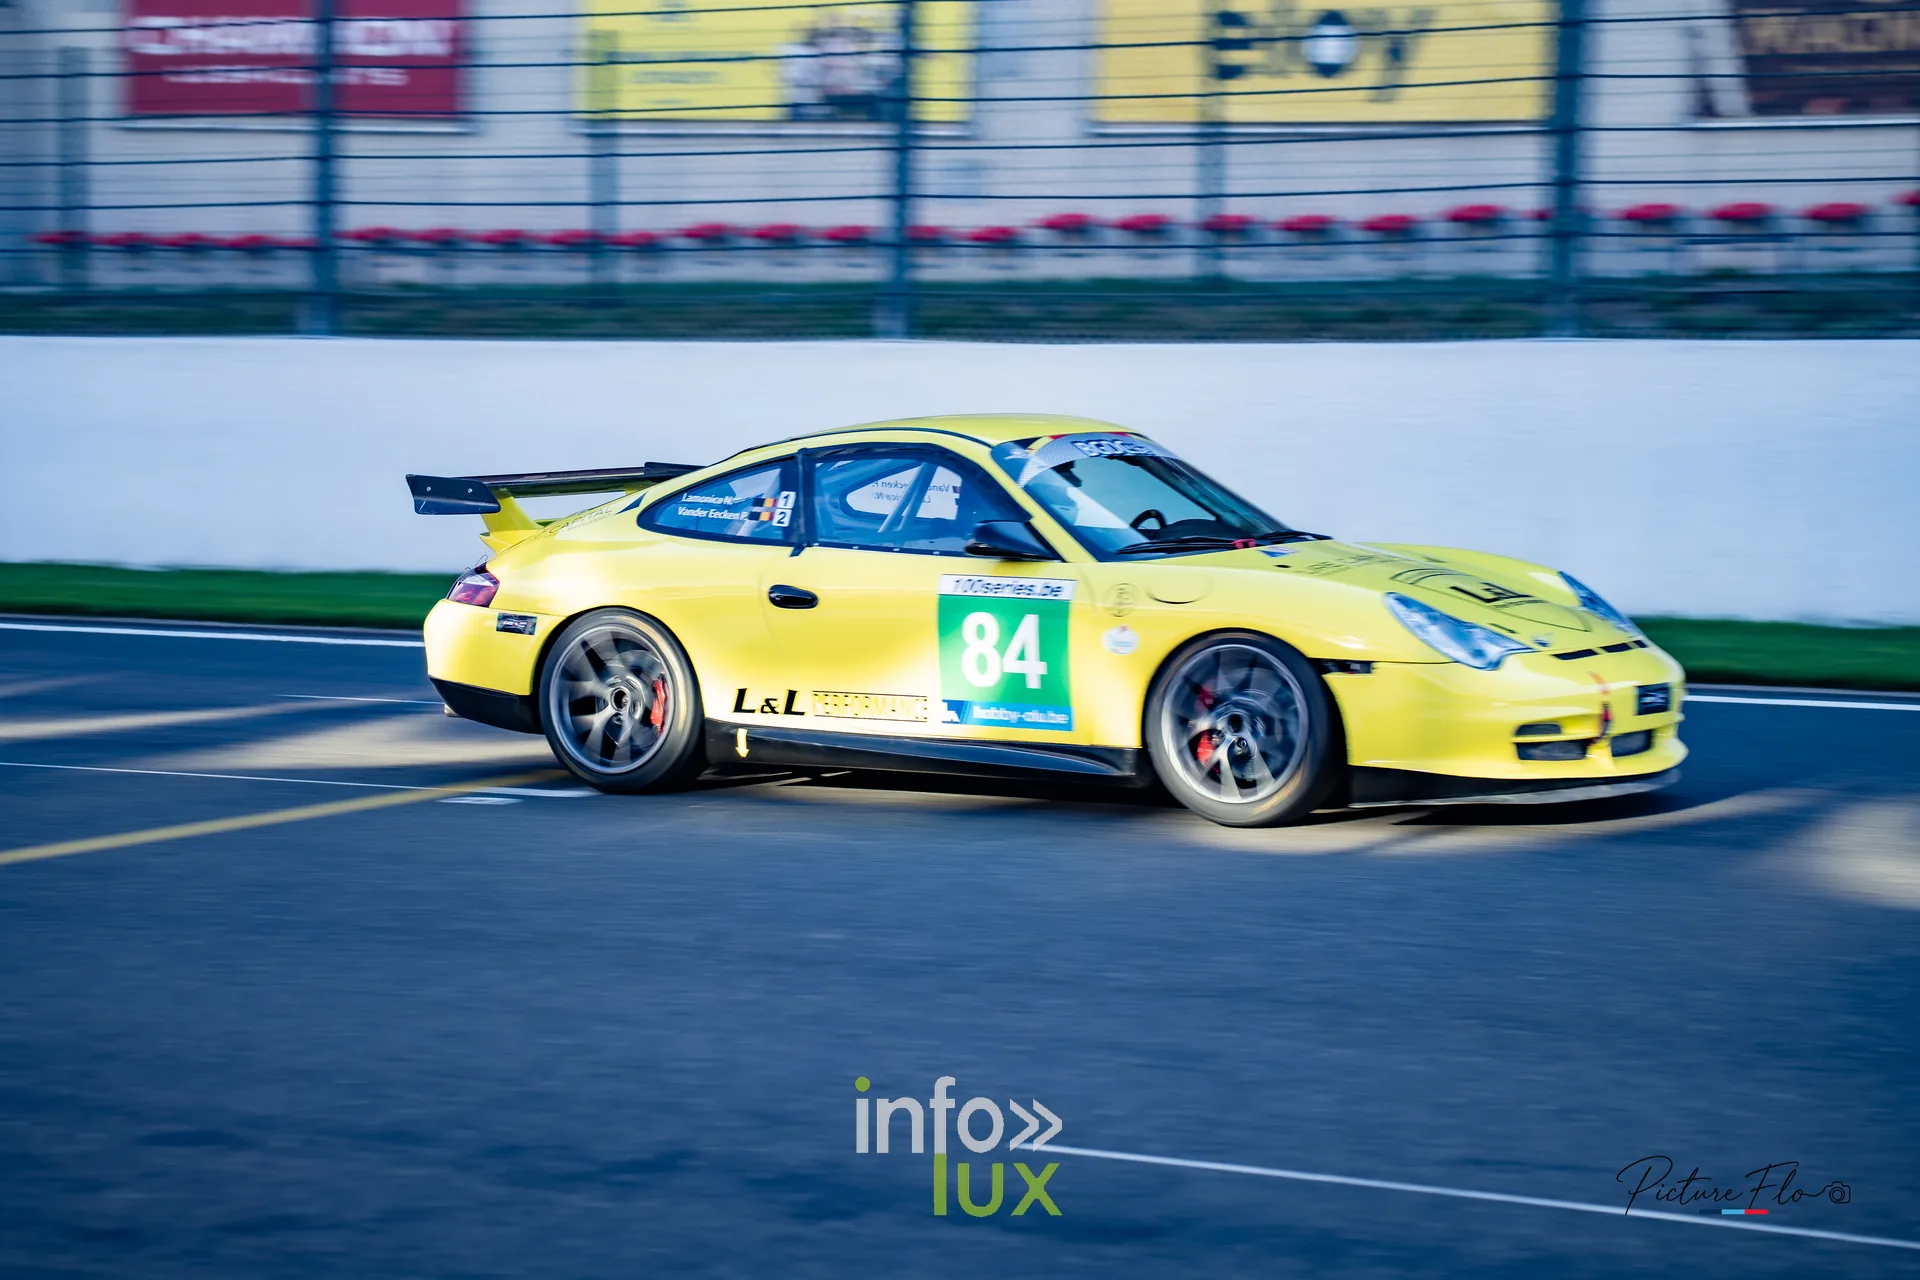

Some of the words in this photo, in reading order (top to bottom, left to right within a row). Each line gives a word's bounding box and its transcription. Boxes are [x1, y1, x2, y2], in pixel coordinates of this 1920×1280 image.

[681, 492, 723, 505] Lamonica
[677, 506, 709, 518] Vander
[953, 578, 1065, 598] 100series.be
[960, 611, 1048, 690] 84
[732, 687, 806, 716] L&L
